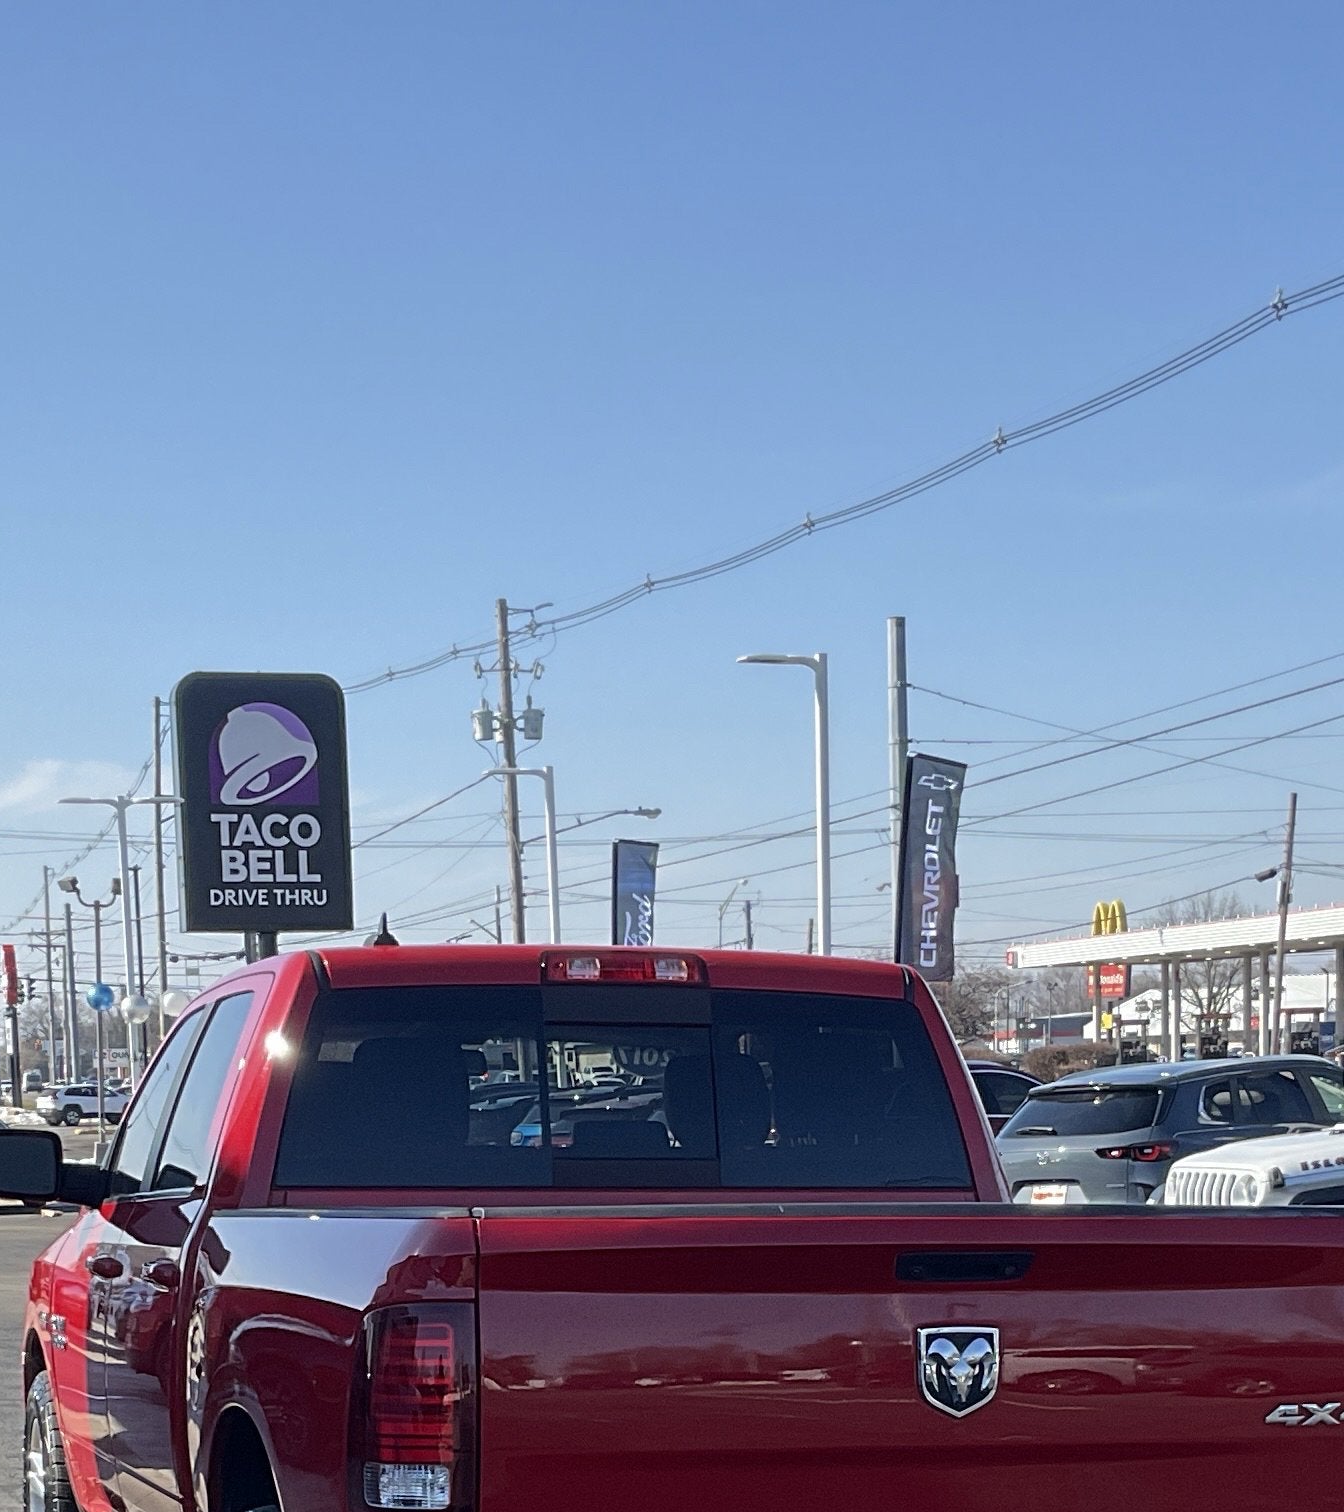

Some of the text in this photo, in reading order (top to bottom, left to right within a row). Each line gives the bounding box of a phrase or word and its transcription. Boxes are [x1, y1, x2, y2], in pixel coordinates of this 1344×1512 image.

[210, 813, 321, 848] TACO
[221, 849, 322, 883] BELL
[919, 798, 945, 959] CHEVROLET
[209, 888, 328, 906] DRIVE THRU
